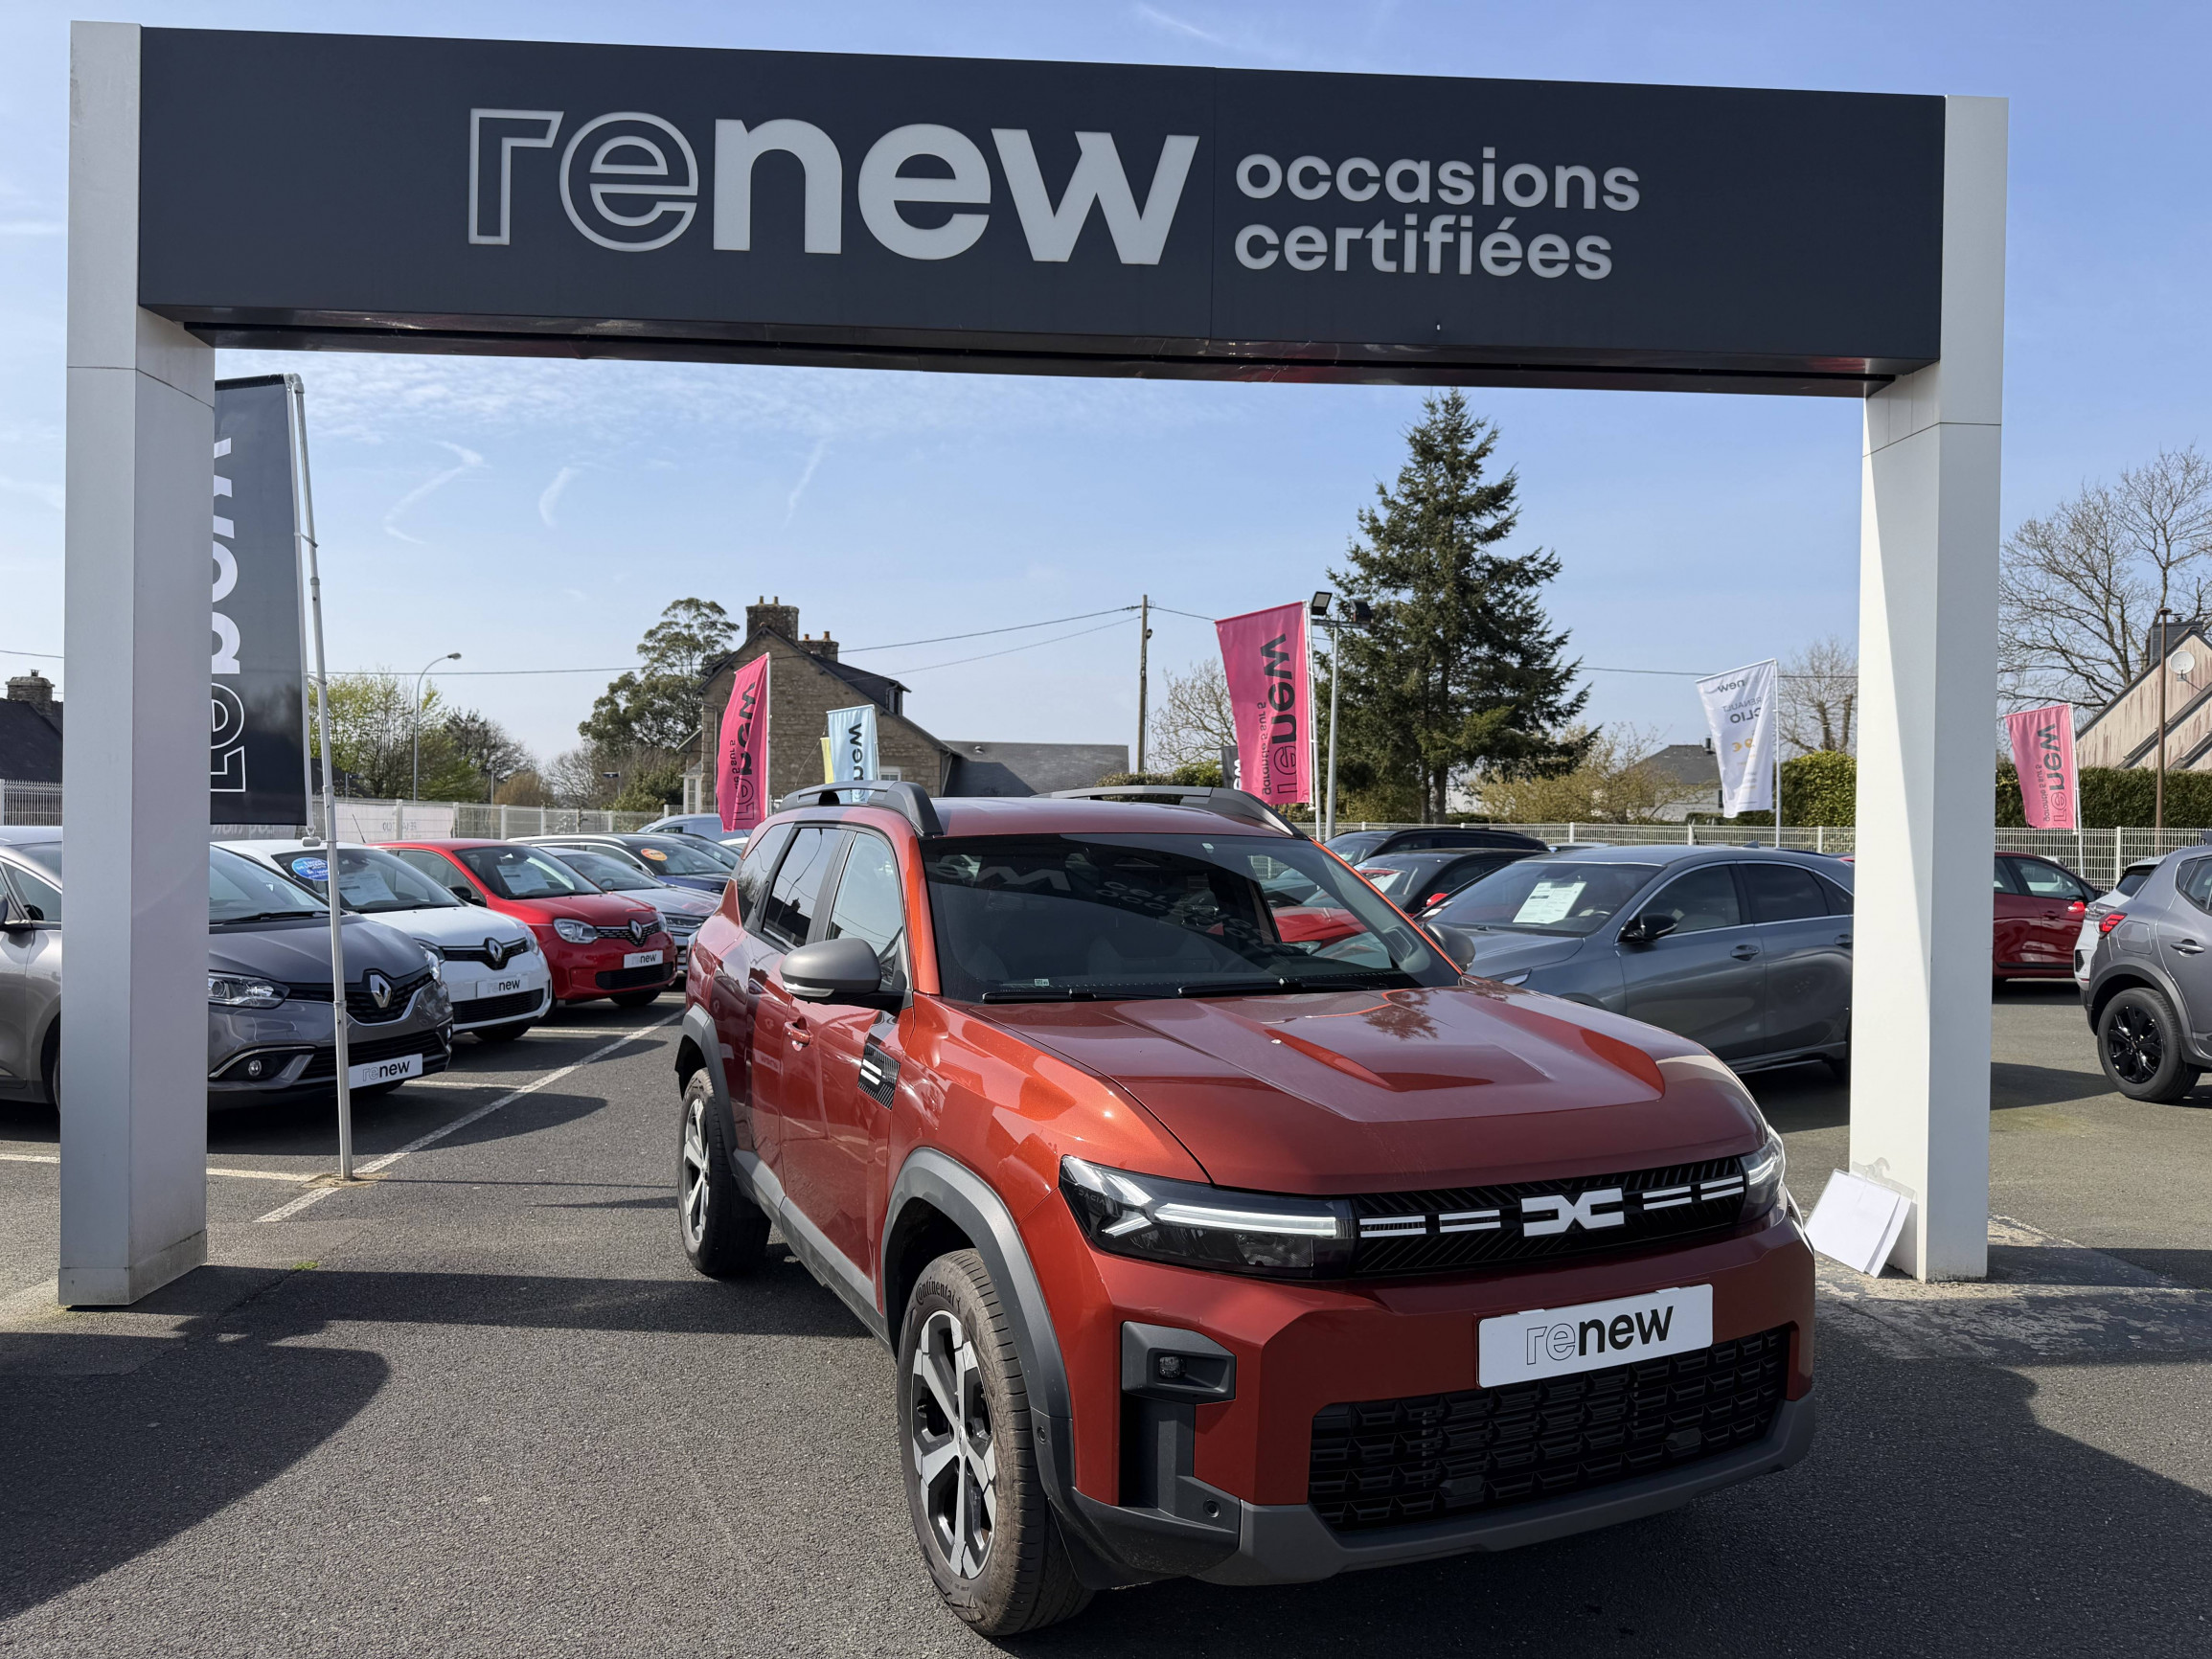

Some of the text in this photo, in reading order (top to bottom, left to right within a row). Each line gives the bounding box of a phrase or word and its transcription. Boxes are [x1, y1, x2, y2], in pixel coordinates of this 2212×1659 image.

[467, 107, 1199, 265] renew
[1236, 147, 1640, 211] occasions
[1235, 213, 1612, 280] certifiées
[362, 1059, 411, 1082] renew
[916, 1276, 956, 1307] Continental
[1526, 1306, 1675, 1366] renew
